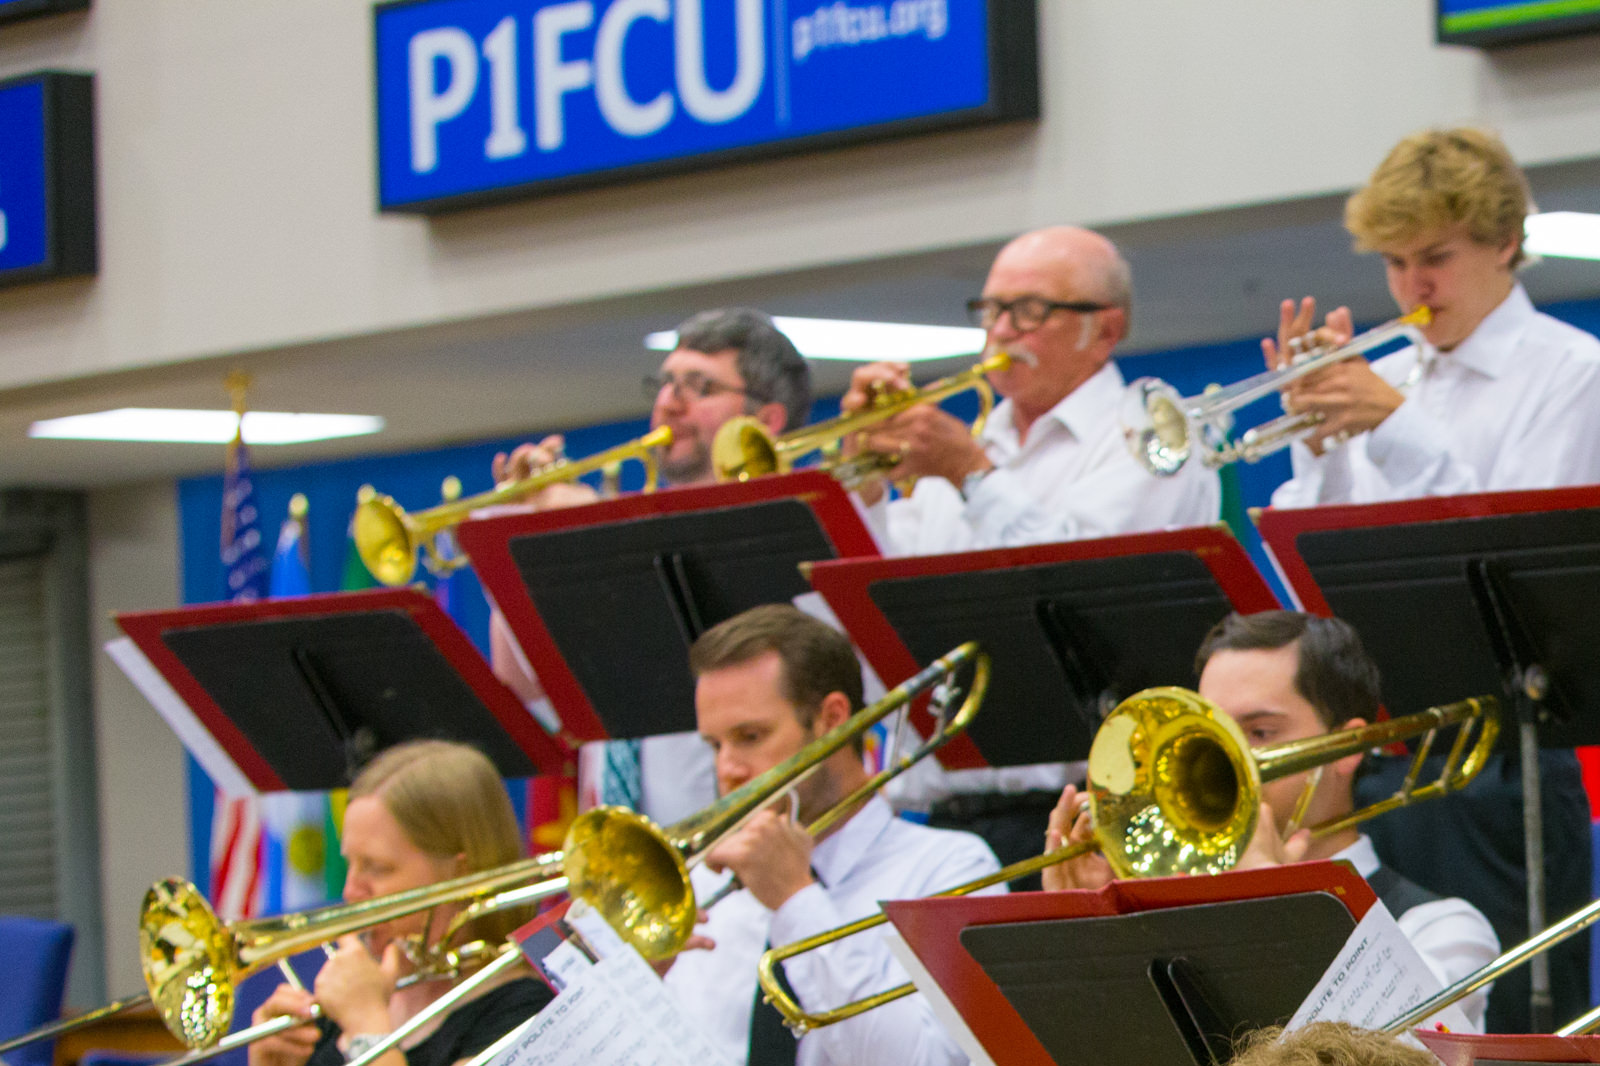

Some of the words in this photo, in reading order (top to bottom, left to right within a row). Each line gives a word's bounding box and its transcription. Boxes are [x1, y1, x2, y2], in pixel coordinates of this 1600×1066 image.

[409, 0, 763, 171] P1FCU
[1333, 971, 1346, 987] TO
[1345, 936, 1369, 971] POINT
[521, 1018, 554, 1050] POLITE
[554, 1003, 569, 1016] TO
